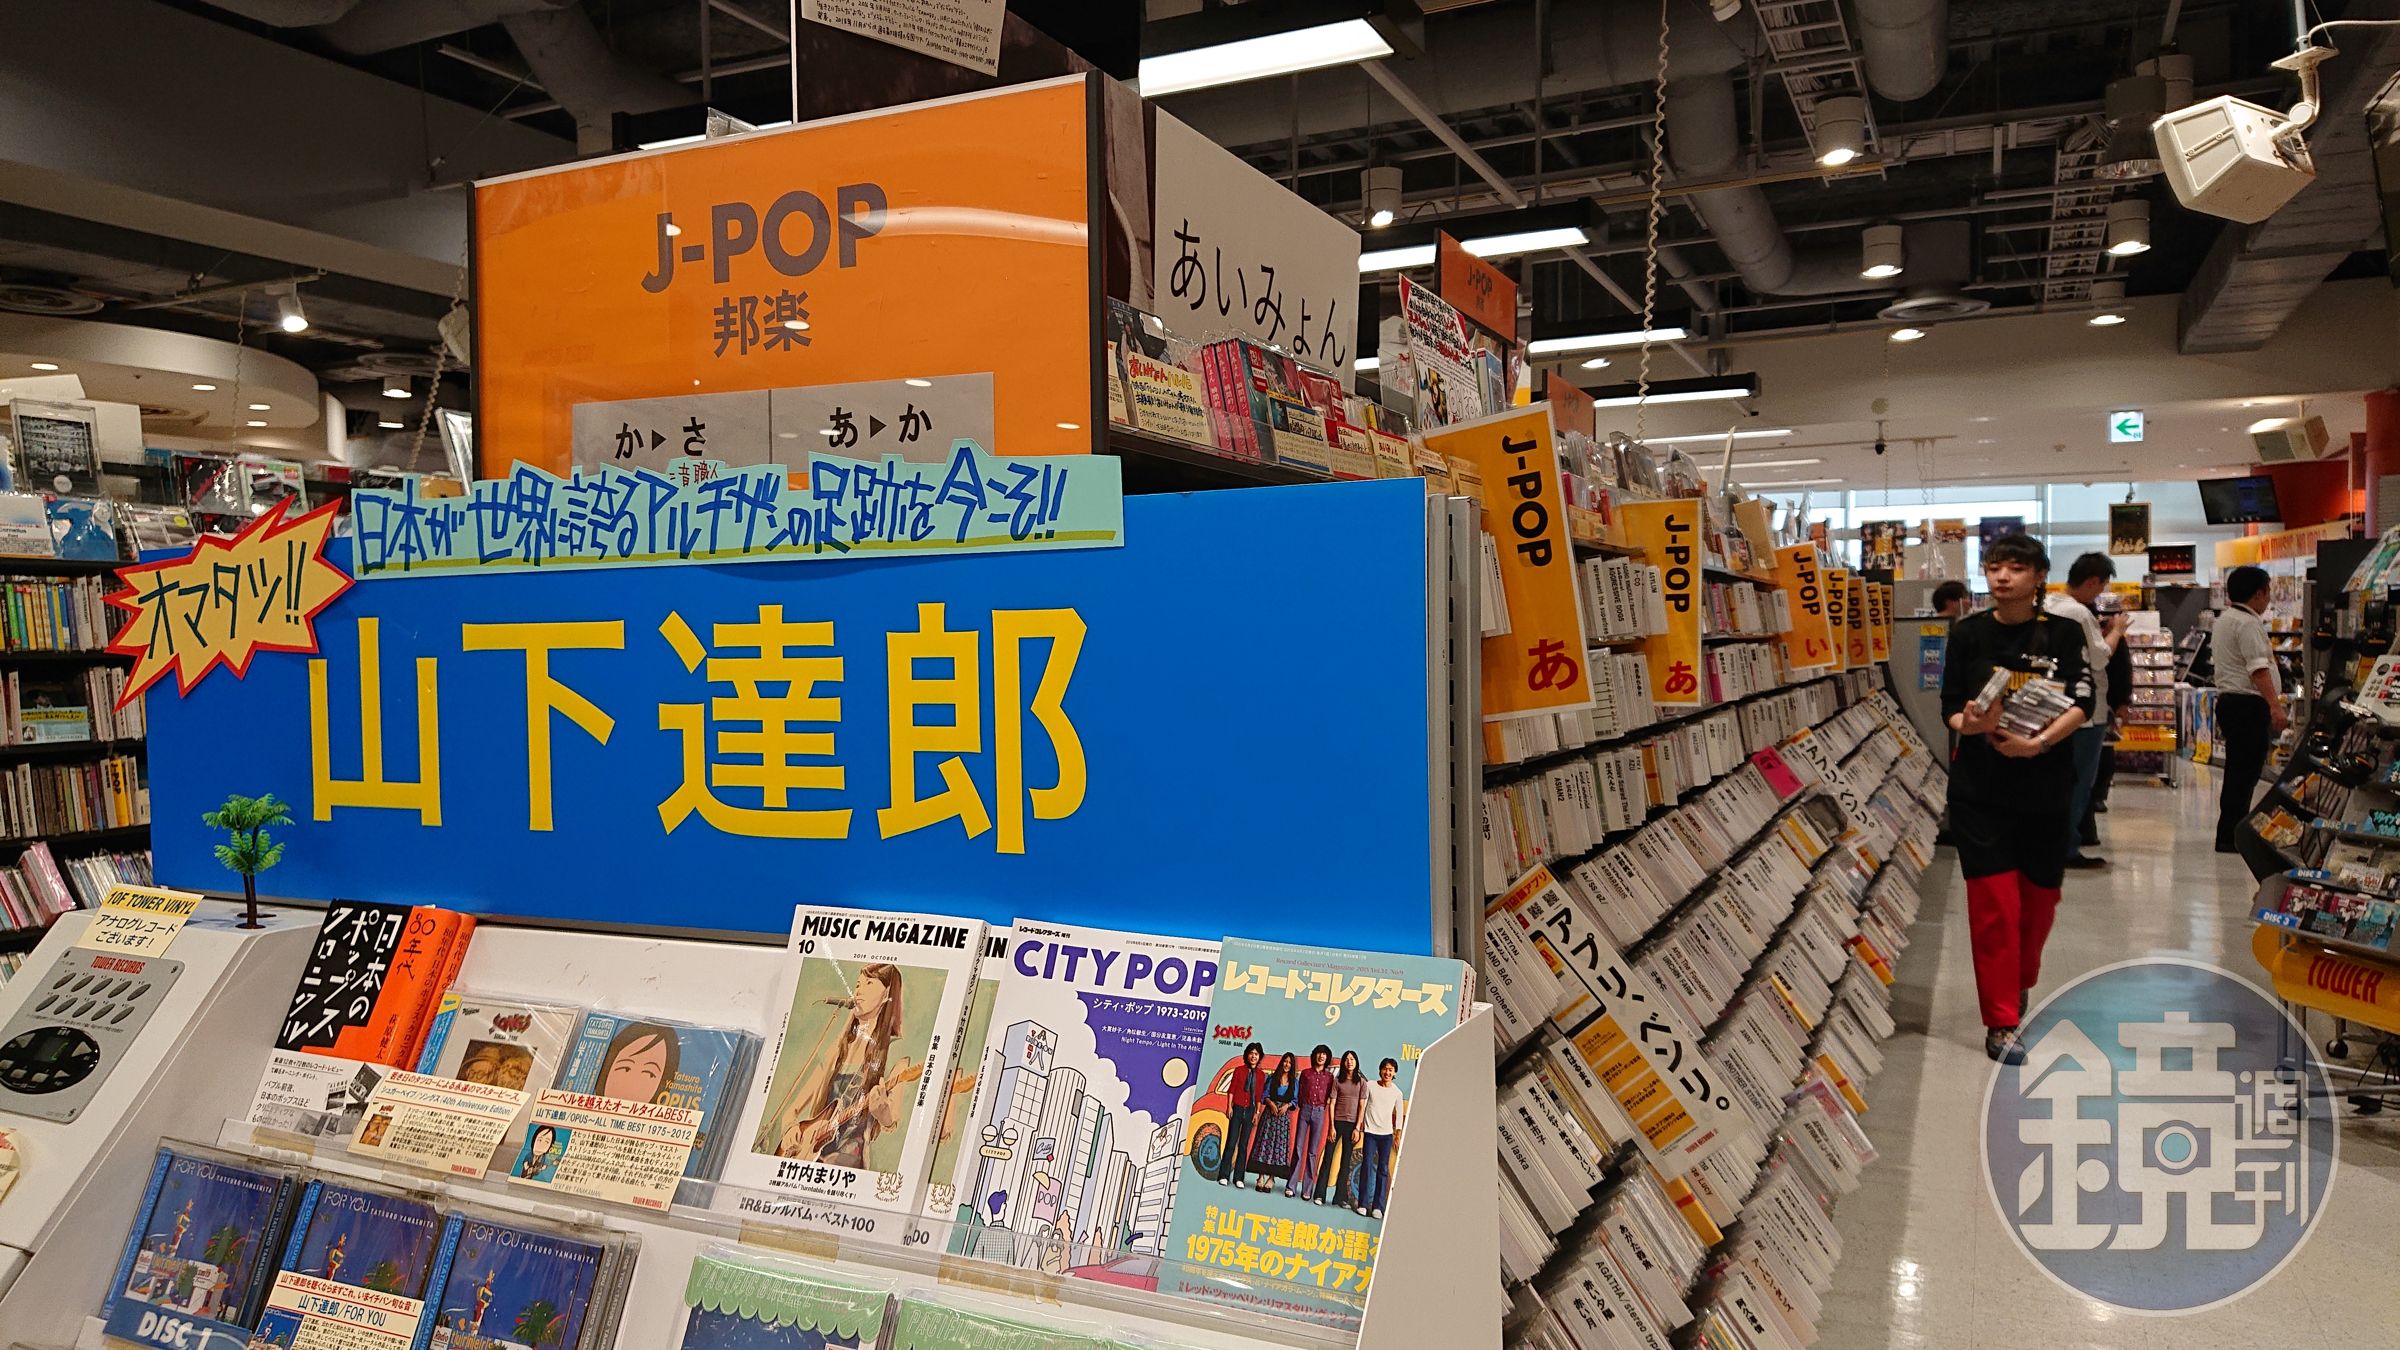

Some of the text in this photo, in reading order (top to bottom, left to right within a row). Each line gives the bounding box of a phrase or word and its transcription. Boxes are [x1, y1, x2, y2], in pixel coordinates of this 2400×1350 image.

[640, 183, 888, 294] J-POP
[1170, 218, 1347, 368] あいみょん
[713, 289, 812, 358] 邦楽
[616, 416, 707, 459] か さ
[829, 403, 932, 448] あ か
[1502, 434, 1554, 567] J-POP
[1664, 514, 1690, 613] J-POP
[1792, 551, 1820, 616] J-POP
[1828, 572, 1843, 626] J-POP
[1867, 586, 1880, 626] J-POP
[1527, 639, 1579, 691] あ
[1806, 638, 1828, 658] い
[1851, 639, 1864, 657] う
[1665, 661, 1697, 695] あ
[308, 602, 1088, 854] 山下達郎
[1554, 777, 1564, 802] ASIAN2
[1806, 745, 1875, 828] アプリ、ベンリ。
[106, 891, 196, 915] 10F TOWER VINYL
[2263, 911, 2283, 925] DISC
[96, 914, 178, 936] アナログレコード
[437, 928, 453, 958] 80年代
[801, 915, 862, 940] MUSIC
[865, 920, 969, 950] MAGAZINE
[91, 955, 146, 975] TOWER RECORDS
[397, 912, 436, 982] 80年代
[798, 940, 815, 954] 10
[283, 907, 353, 1044] クロニクル
[308, 909, 382, 1039] ポップス
[348, 914, 403, 1020] 日本の
[1013, 940, 1219, 998] CITY POP
[1499, 968, 1513, 986] BAG
[2307, 955, 2384, 1005] TOWER
[1223, 960, 1453, 1017] レコード・コレクターズ
[1489, 985, 1517, 1025] Orchestra
[1092, 998, 1208, 1021] シティ・ポップ 1973-2019
[1325, 1005, 1341, 1026] 9
[1546, 907, 1730, 1111] アプリ、ベンリ。
[933, 1035, 940, 1051] 特集
[1121, 1036, 1135, 1046] Night
[1212, 1024, 1253, 1040] SONGS
[665, 1079, 703, 1093] Yamashita
[673, 1071, 701, 1082] Tatsuro
[1724, 1059, 1762, 1110] ANOTHER STORY
[260, 1091, 310, 1108] 日本のポップスほど
[540, 1089, 694, 1124] レーベルを越えたオールタイムBEST。
[656, 1091, 702, 1110] OPUS
[610, 1119, 692, 1141] TIME BEST 1975-2012
[1498, 1125, 1530, 1171] aoki laska
[174, 1159, 273, 1194] FOR YOU TATSURO YAMASHITA
[777, 1160, 857, 1189] 特集 竹内まりや
[325, 1190, 434, 1229] FOR YOU TATSURO YAMASHITA
[1037, 1191, 1057, 1207] POP
[1203, 1205, 1219, 1234] 特集
[467, 1224, 595, 1265] FOR YOU TATSURO YAMASHITA
[697, 1264, 757, 1299] PACIFIC
[1595, 1260, 1647, 1333] AGATHA/stereo
[297, 1294, 387, 1327] 山下達郎/FOR YOU
[136, 1310, 194, 1350] DISC
[906, 1309, 1037, 1350] PACIFIC BREEZE
